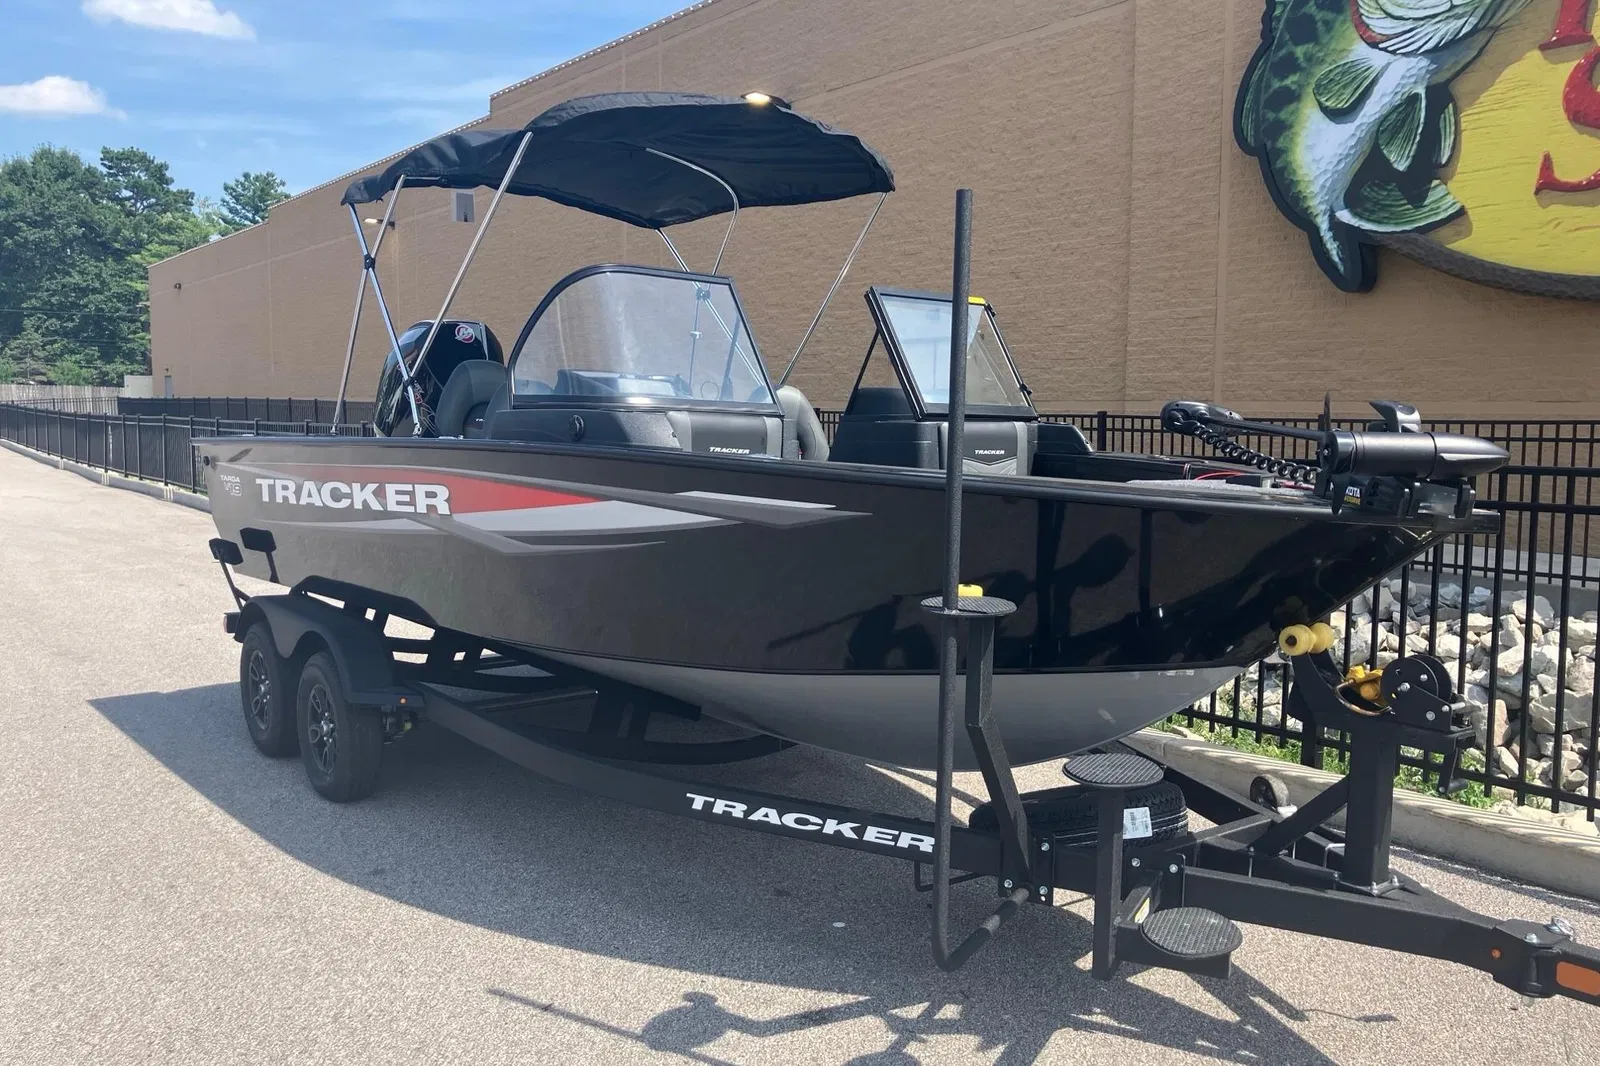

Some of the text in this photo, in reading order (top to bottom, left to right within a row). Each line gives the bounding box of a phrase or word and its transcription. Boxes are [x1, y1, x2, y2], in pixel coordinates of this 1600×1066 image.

[709, 446, 750, 454] TRACKER
[220, 474, 241, 483] TARGA
[255, 478, 451, 515] TRACKER
[686, 793, 936, 853] TRACKER
